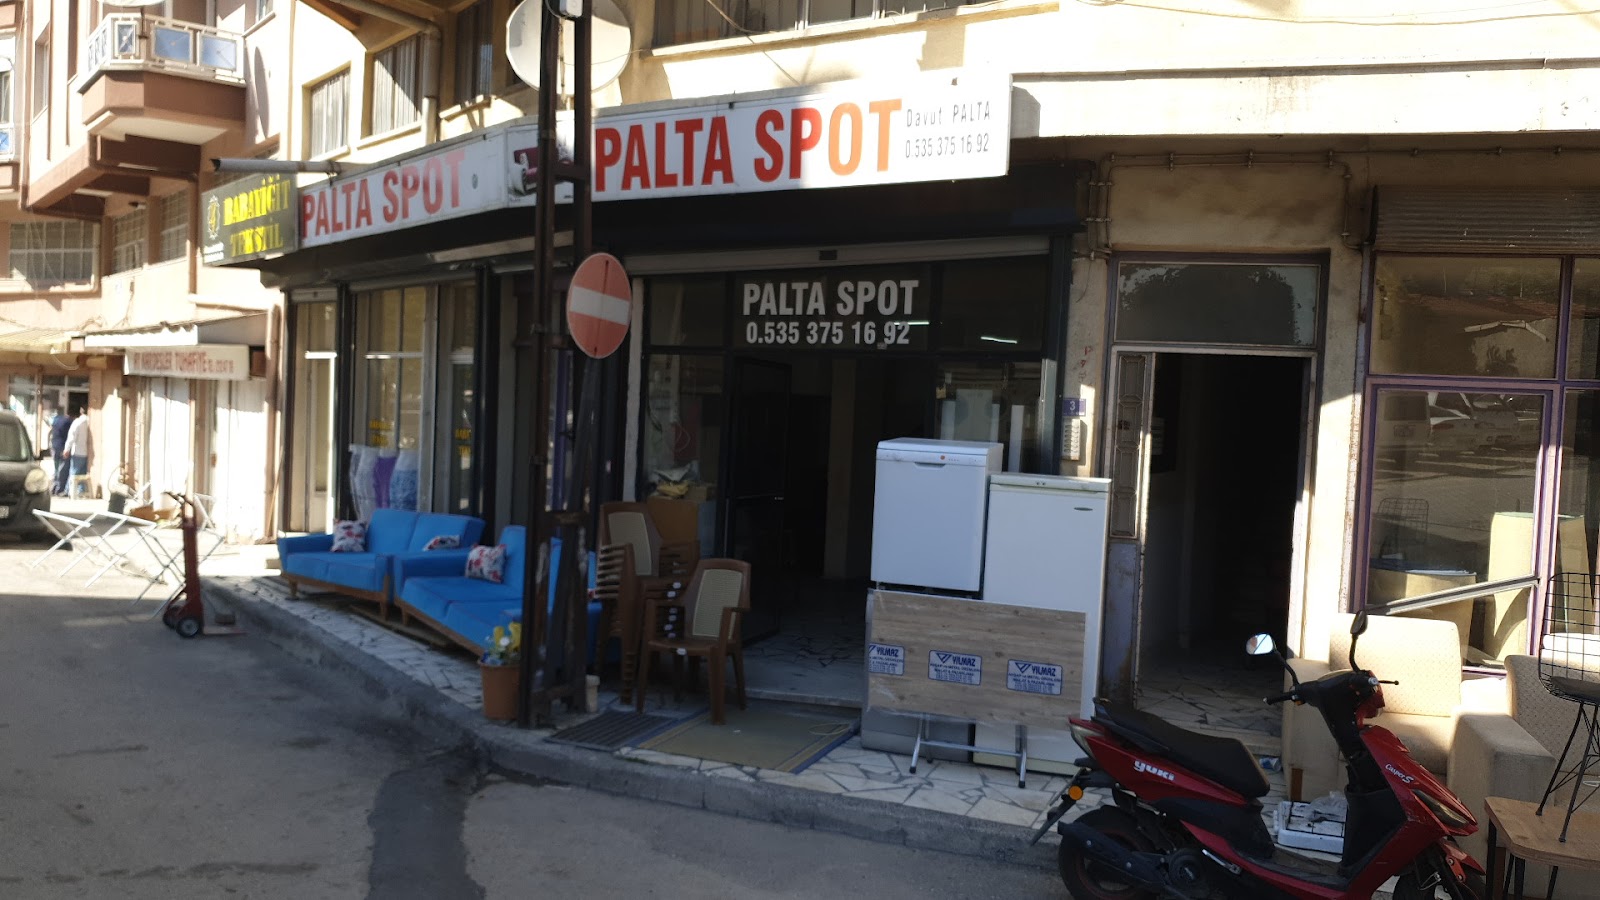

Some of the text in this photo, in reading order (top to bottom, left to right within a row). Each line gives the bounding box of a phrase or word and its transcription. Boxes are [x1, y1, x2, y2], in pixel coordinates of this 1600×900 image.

[906, 101, 990, 128] Davut PALTA
[594, 98, 902, 192] PALTA SPOT
[905, 132, 990, 158] 0.535 375 16 92
[301, 150, 466, 240] PALTA SPOT
[742, 279, 920, 316] PALTA SPOT
[746, 321, 910, 345] 0.535 375 16 92
[1069, 400, 1076, 411] 3
[876, 646, 899, 658] YILMAZ
[952, 655, 976, 667] YILMAZ
[1031, 665, 1056, 677] YILMAZ
[1133, 760, 1175, 781] yuki
